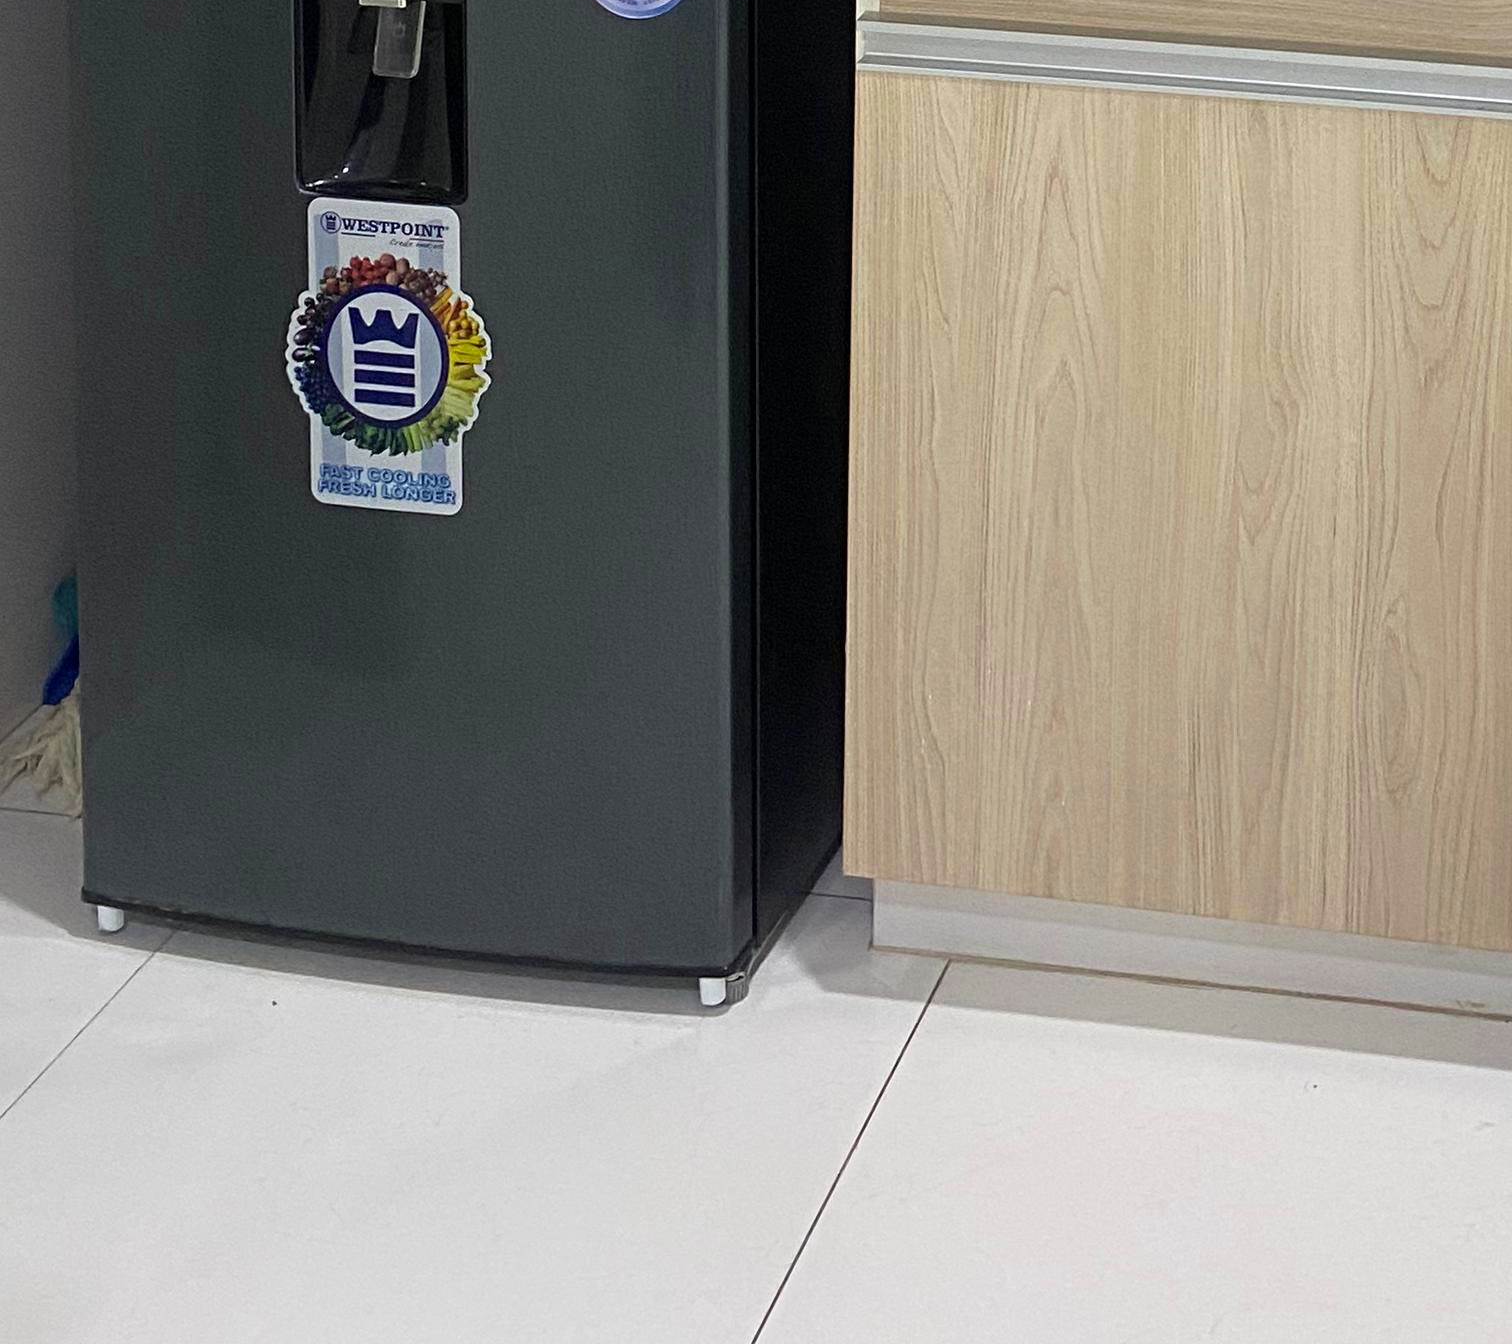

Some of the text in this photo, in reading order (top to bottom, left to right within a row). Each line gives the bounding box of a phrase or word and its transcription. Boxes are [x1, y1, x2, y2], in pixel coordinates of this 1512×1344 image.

[341, 218, 445, 238] WESTPOINT
[319, 463, 451, 488] FAST COOLING
[317, 478, 457, 504] FRESH LONGER
